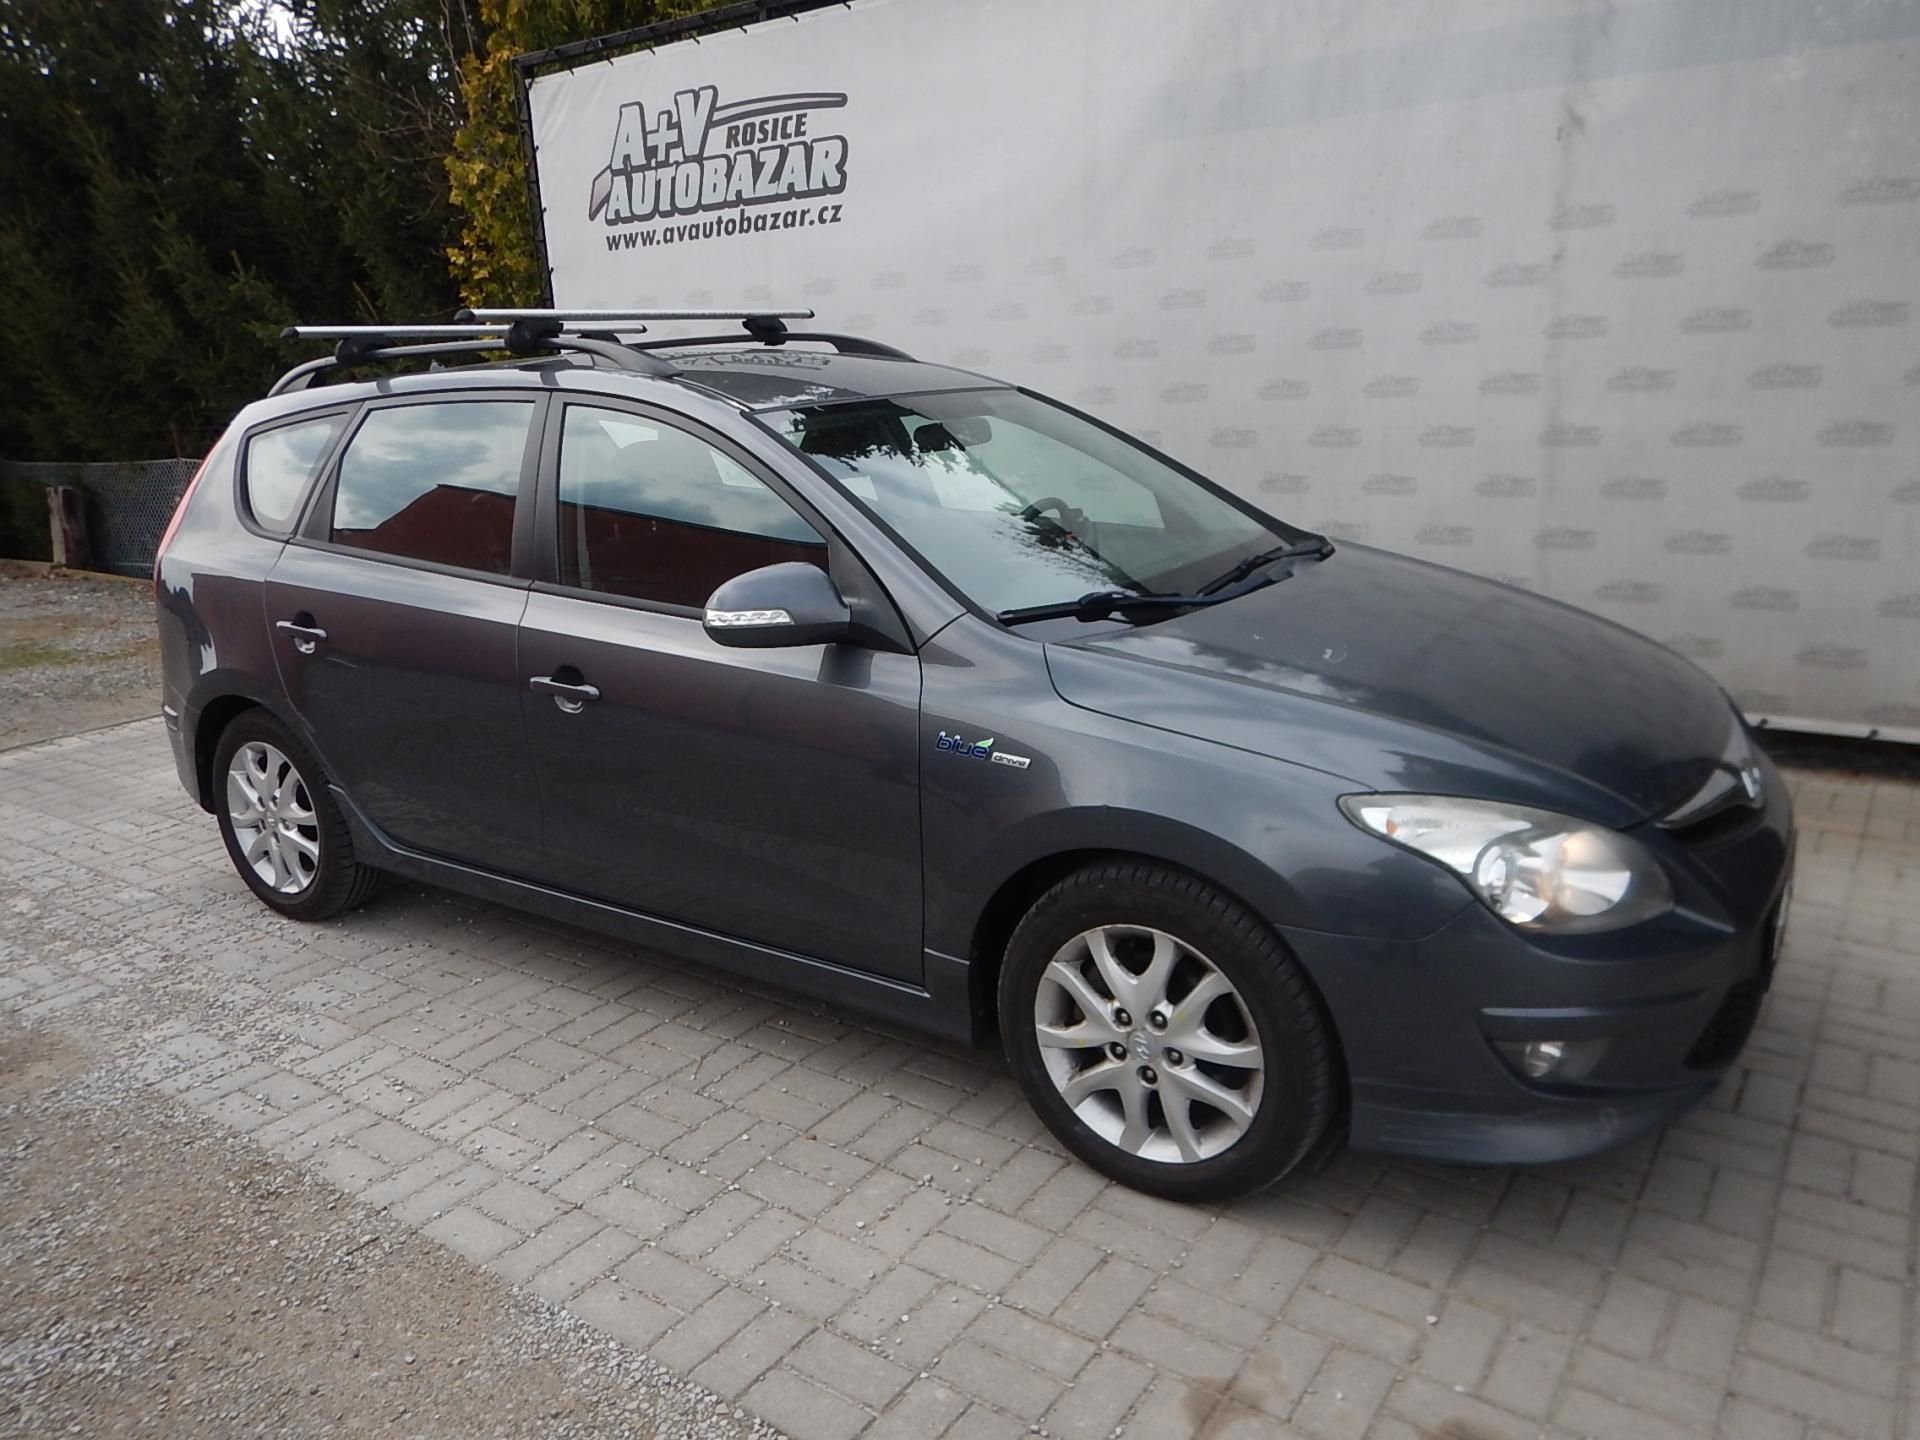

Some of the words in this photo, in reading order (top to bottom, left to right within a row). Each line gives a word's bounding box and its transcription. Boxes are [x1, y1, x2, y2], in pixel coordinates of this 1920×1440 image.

[611, 84, 719, 170] A+V
[726, 112, 808, 149] ROSICE
[604, 135, 848, 226] AUTOBAZAR
[606, 204, 843, 251] www.avautobazar.cz
[936, 731, 989, 759] blue
[993, 755, 1027, 768] drive
